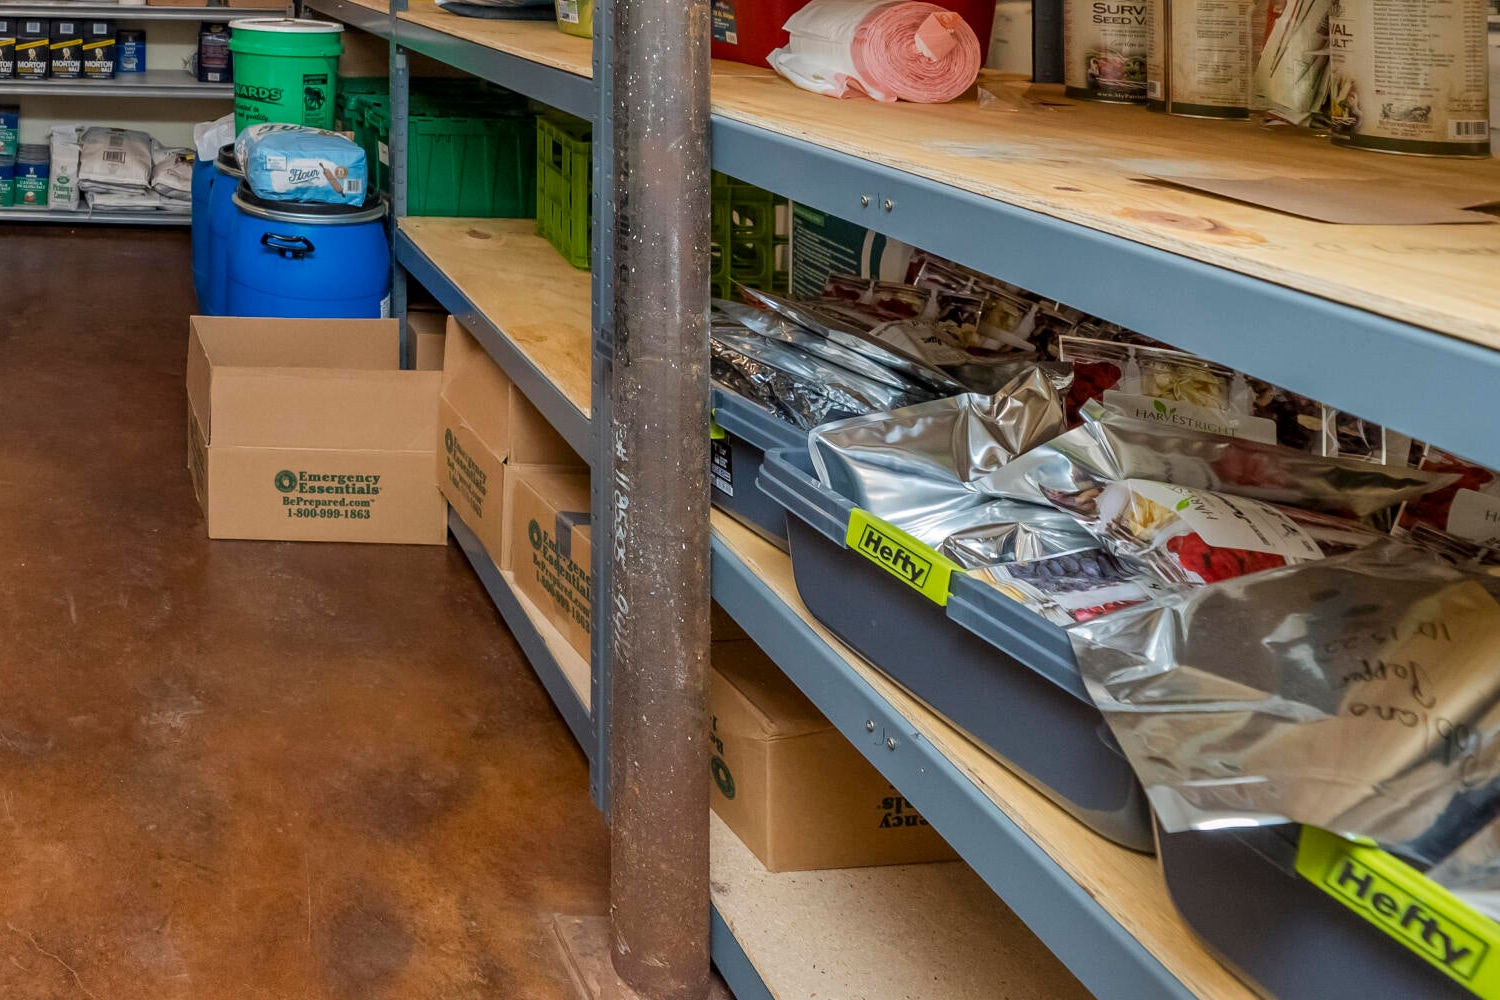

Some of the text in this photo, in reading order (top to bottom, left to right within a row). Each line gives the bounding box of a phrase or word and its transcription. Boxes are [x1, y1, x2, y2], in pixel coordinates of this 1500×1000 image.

[1092, 15, 1131, 25] SEED
[245, 112, 269, 122] quality
[288, 168, 319, 184] Flour
[298, 471, 381, 485] Emergency
[298, 483, 380, 495] Essentials
[282, 496, 371, 508] BePrepared.com
[287, 508, 371, 519] 1-800-999-1863
[865, 530, 924, 582] Hefty
[1338, 861, 1472, 966] Hefty
